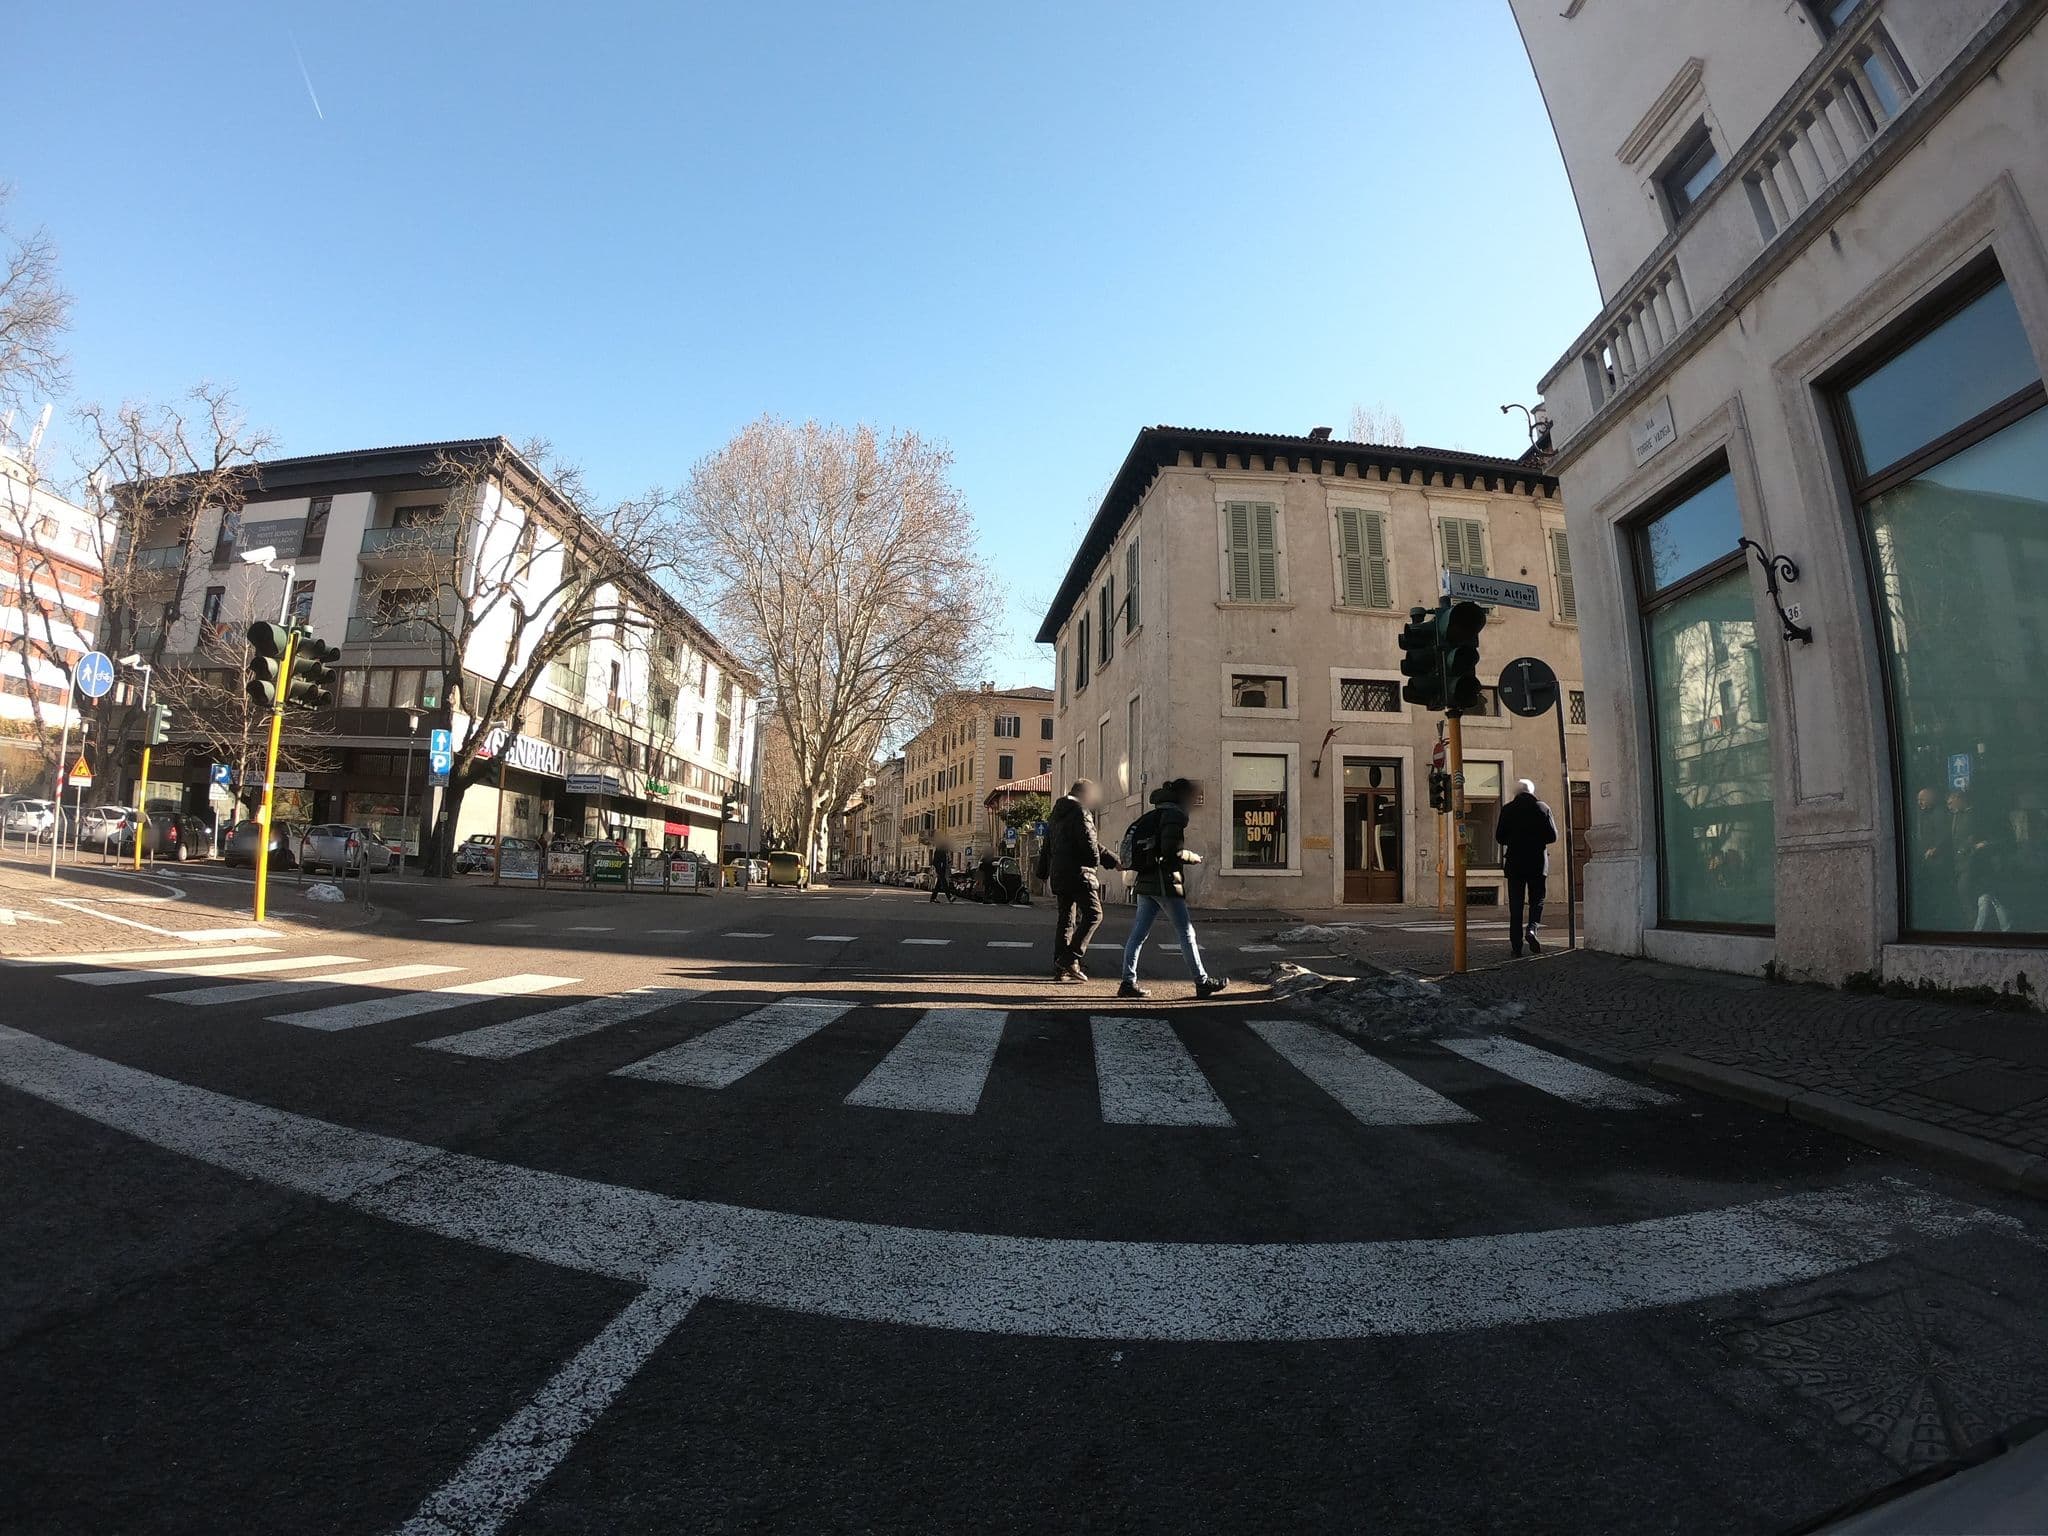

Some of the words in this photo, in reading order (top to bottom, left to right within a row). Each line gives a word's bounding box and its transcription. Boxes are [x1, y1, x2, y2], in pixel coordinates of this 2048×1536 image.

[1645, 416, 1655, 430] VIA
[1460, 582, 1499, 596] Vittorio
[1504, 588, 1536, 602] Alfieri
[433, 754, 447, 773] P
[1244, 811, 1275, 826] SALDI
[594, 859, 626, 869] SUBWAY
